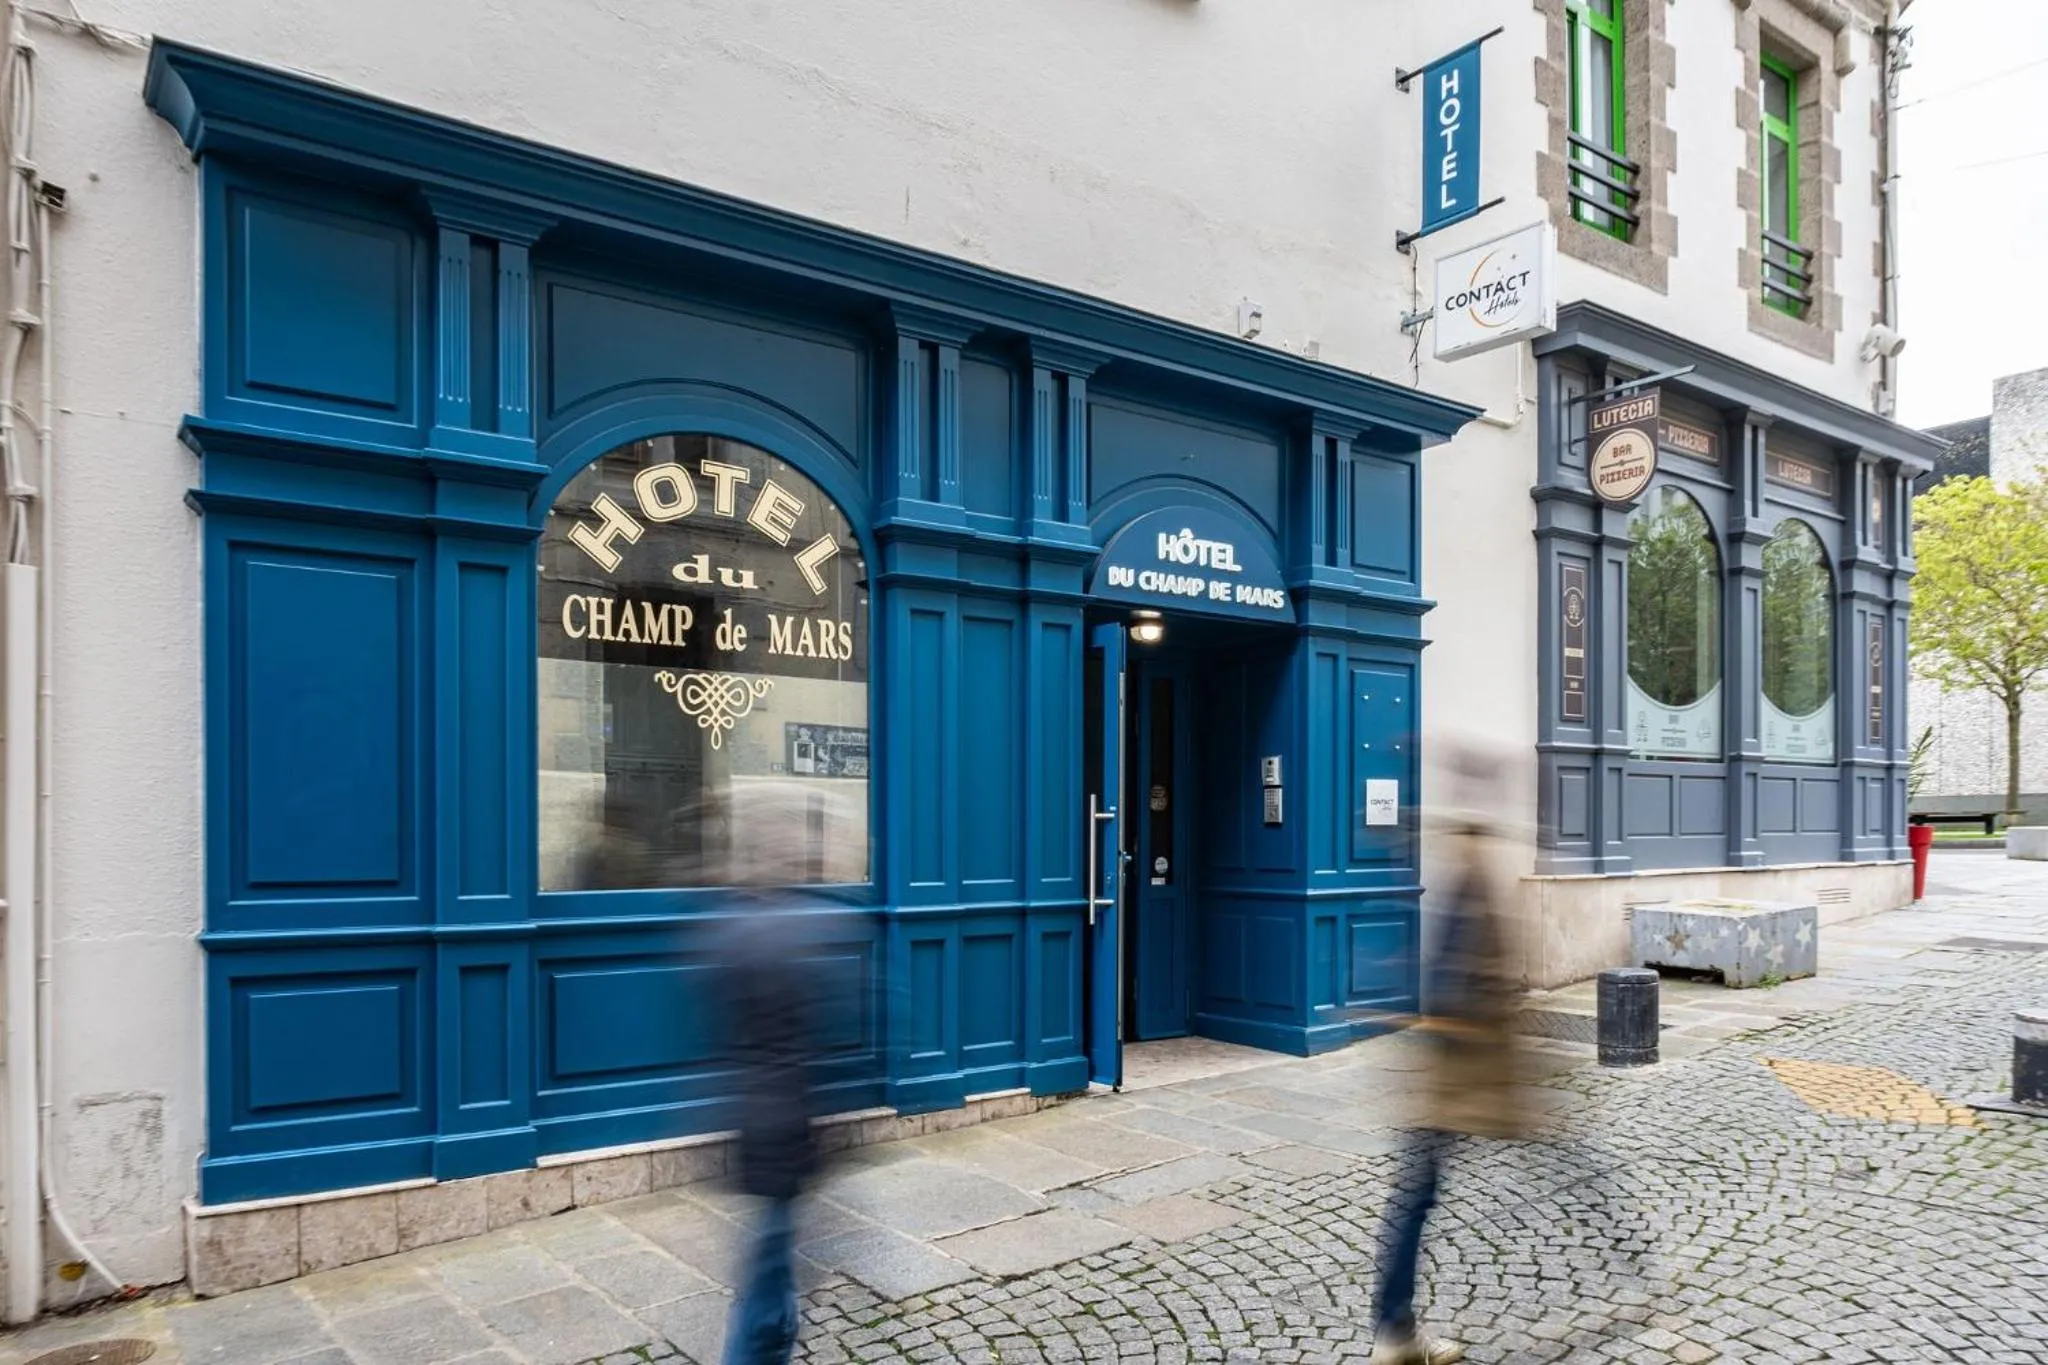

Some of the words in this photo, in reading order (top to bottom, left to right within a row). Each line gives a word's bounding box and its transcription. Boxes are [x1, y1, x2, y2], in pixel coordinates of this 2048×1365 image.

[1439, 69, 1461, 209] HOTEL
[1444, 270, 1531, 311] CONTACT
[1483, 294, 1521, 317] Hotels
[1593, 399, 1654, 429] LUTECIA
[1612, 444, 1633, 458] BAR
[1599, 465, 1646, 486] PIZZERIA
[568, 459, 840, 595] HOTEL
[1157, 528, 1243, 572] HÔTEL
[672, 554, 759, 589] du
[1108, 566, 1135, 587] DU
[1138, 570, 1204, 597] CHAMP
[1208, 580, 1232, 602] DE
[1236, 585, 1284, 609] MARS
[562, 594, 693, 647] CHAMP
[716, 608, 748, 653] de
[767, 614, 853, 661] MARS
